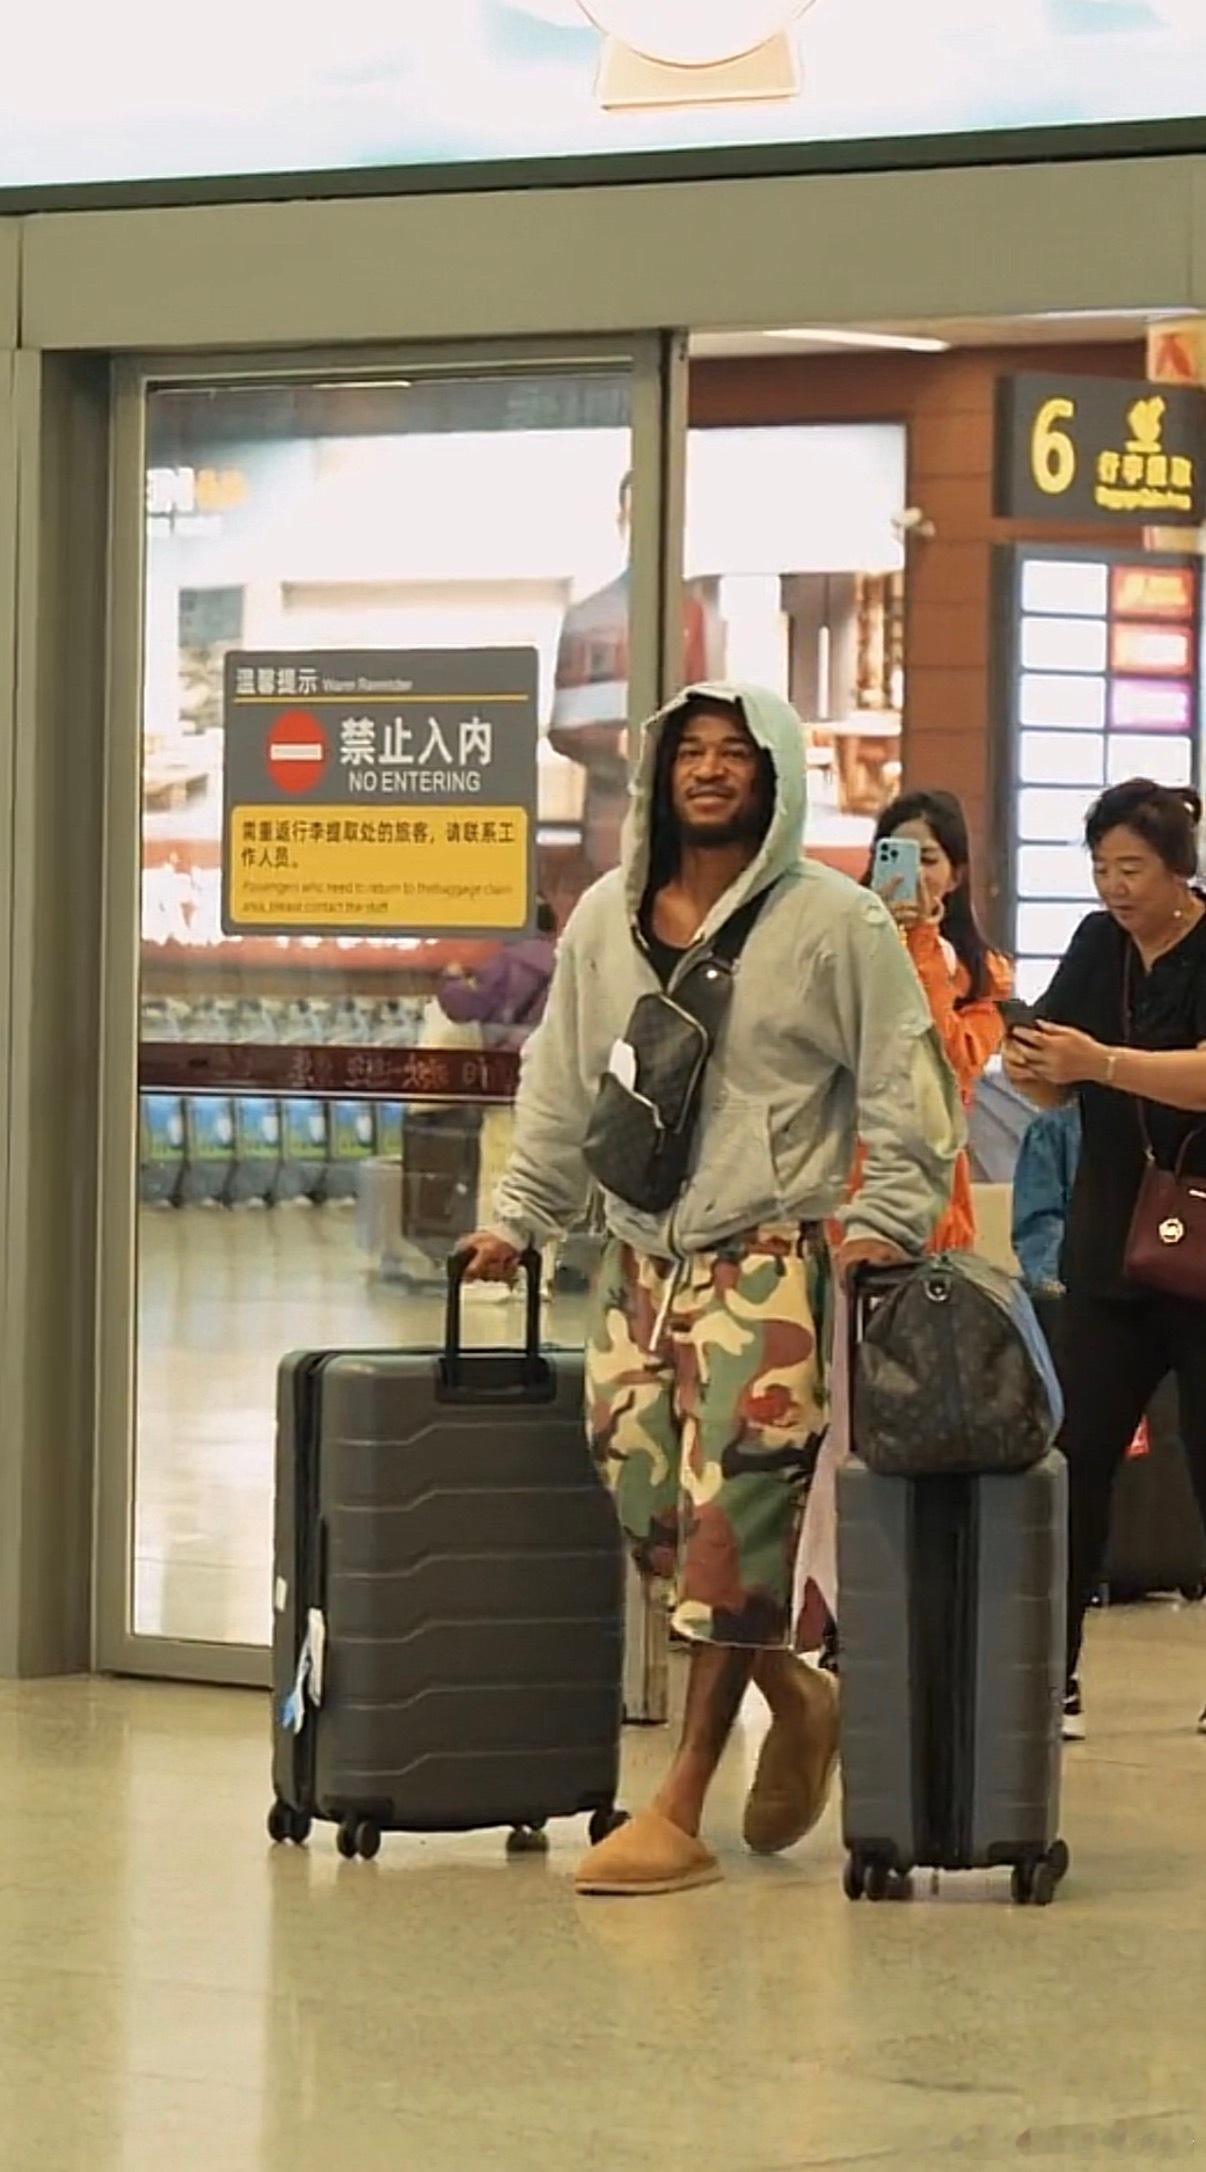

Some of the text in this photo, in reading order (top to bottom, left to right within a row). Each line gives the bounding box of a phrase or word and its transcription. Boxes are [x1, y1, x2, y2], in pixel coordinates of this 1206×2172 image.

[1032, 398, 1075, 494] 6
[236, 667, 317, 695] 温馨提示
[340, 716, 492, 766] 禁止入内
[350, 771, 481, 793] NO ENTERING
[241, 847, 299, 868] 作人员。
